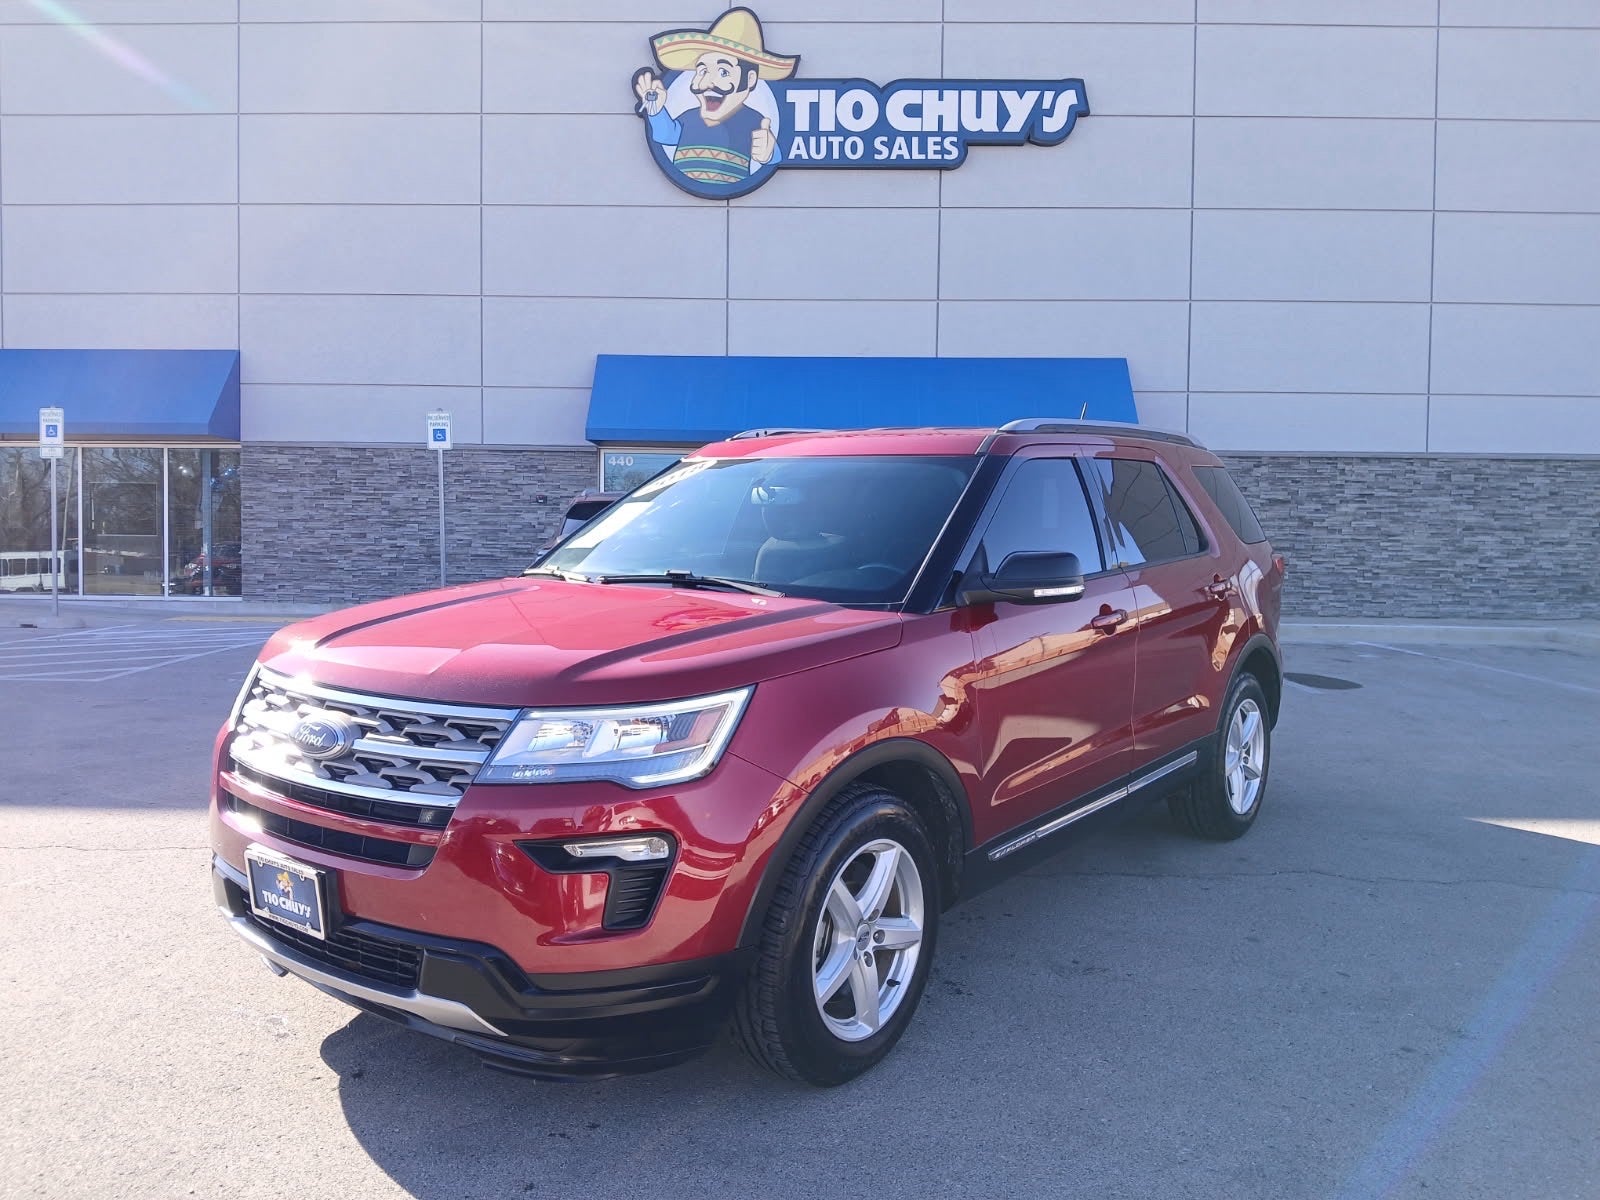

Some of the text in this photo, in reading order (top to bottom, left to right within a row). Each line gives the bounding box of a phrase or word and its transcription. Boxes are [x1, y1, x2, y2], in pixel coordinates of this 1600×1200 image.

[786, 89, 1078, 132] TIO CHUY'S
[788, 136, 959, 161] AUTO SALES
[608, 456, 634, 466] 440
[294, 723, 327, 747] Ford
[261, 889, 311, 918] TIO CHUY'S
